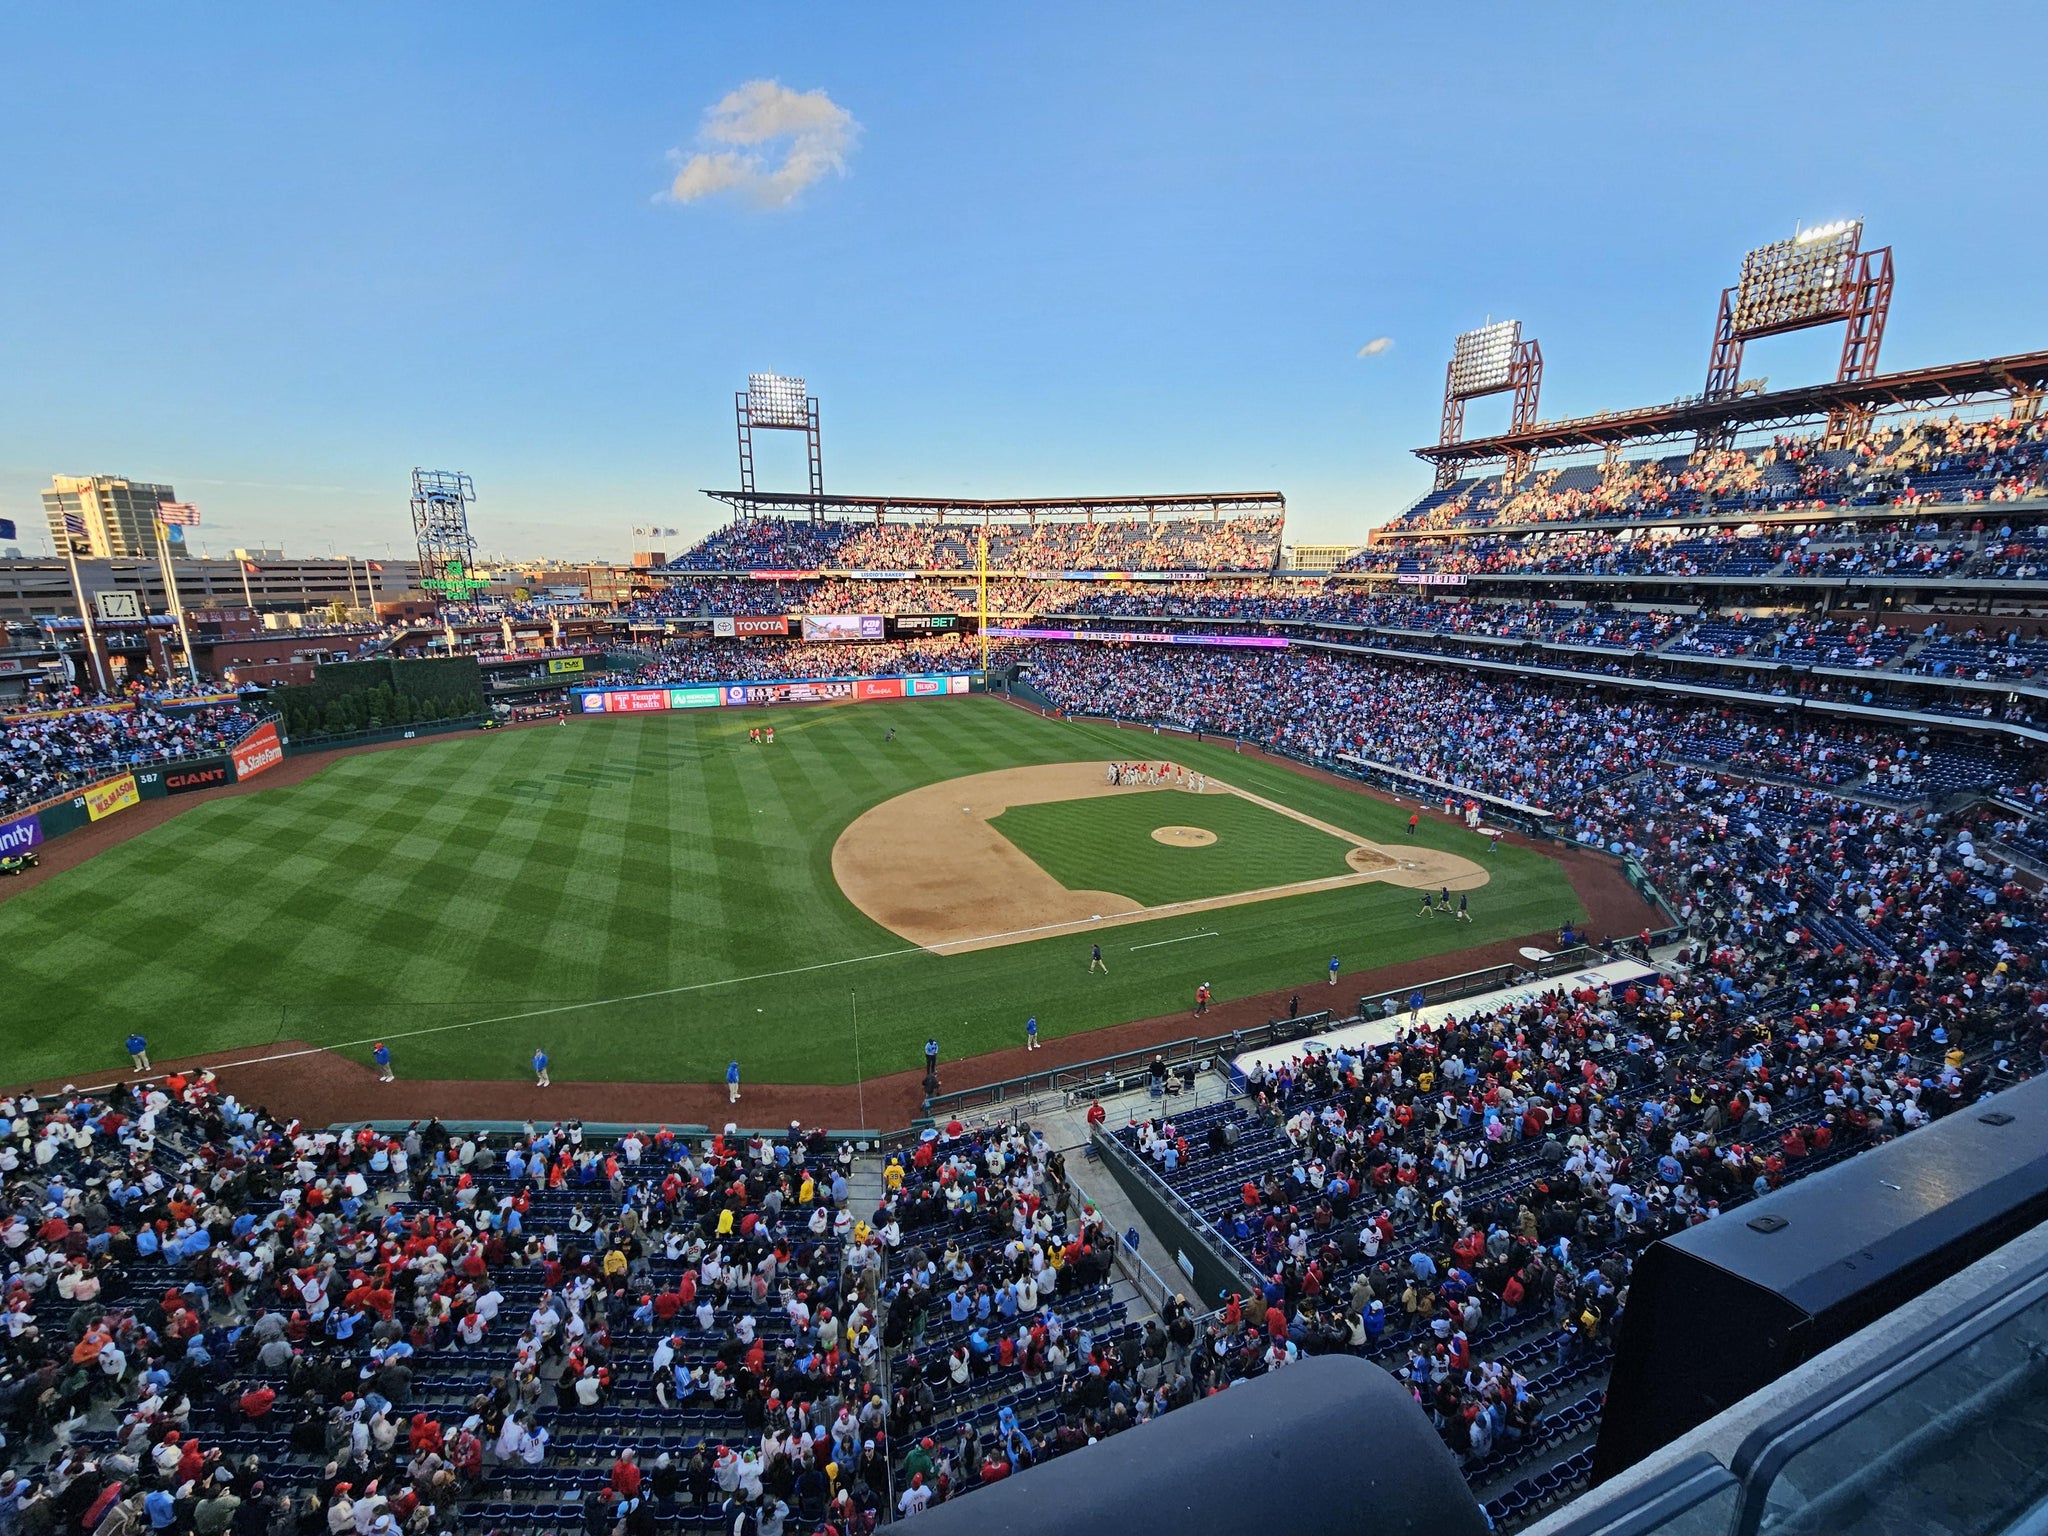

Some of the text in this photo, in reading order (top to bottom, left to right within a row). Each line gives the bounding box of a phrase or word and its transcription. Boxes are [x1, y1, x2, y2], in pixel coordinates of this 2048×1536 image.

[420, 578, 491, 589] Citizens Bank
[446, 589, 470, 601] Park
[737, 621, 784, 631] TOYOTA
[897, 617, 956, 628] ESPN BET
[631, 691, 661, 703] Temple
[632, 699, 660, 709] Health
[140, 774, 158, 784] 387
[166, 769, 225, 788] GIANT
[344, 1411, 360, 1423] 20
[912, 1501, 924, 1513] 10
